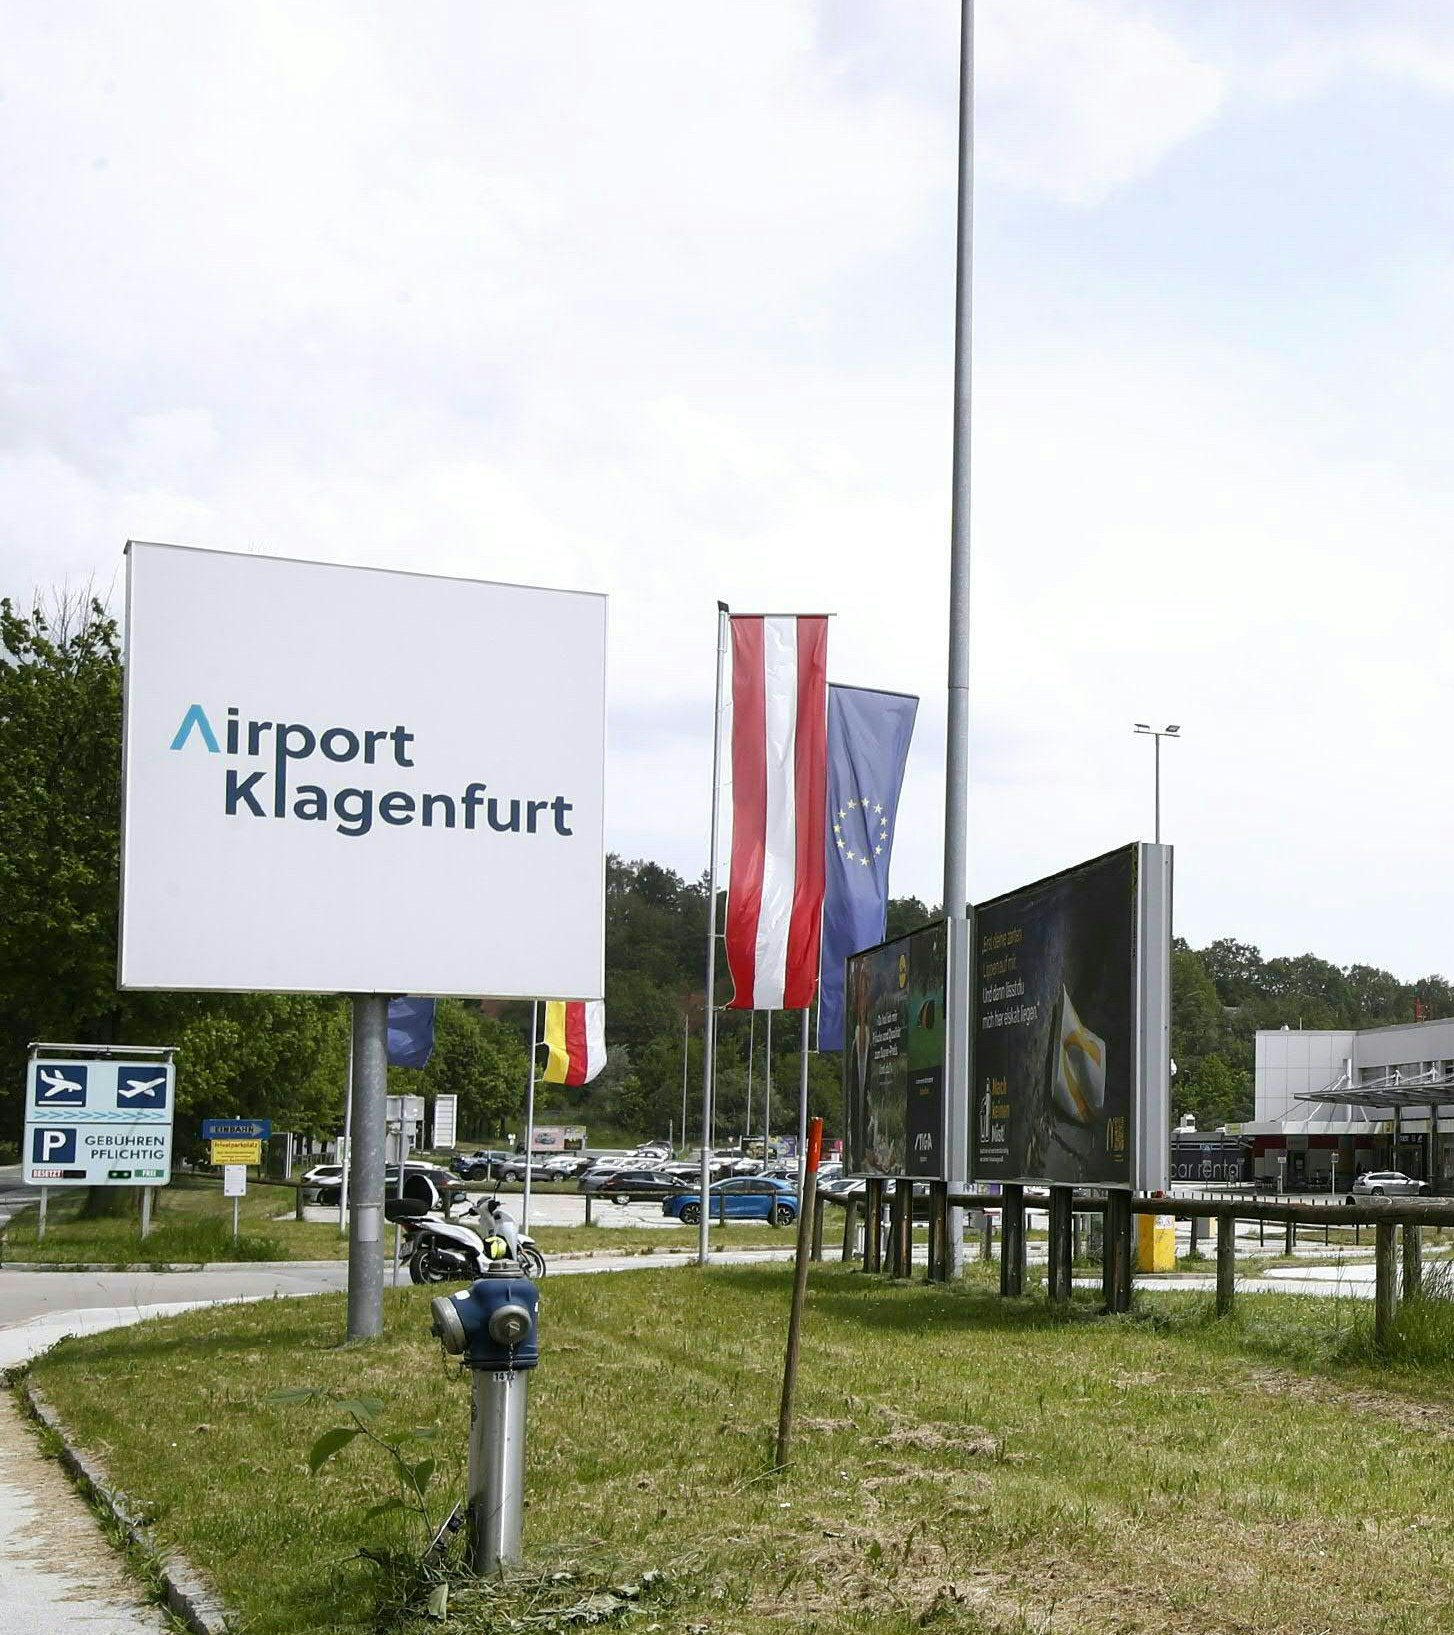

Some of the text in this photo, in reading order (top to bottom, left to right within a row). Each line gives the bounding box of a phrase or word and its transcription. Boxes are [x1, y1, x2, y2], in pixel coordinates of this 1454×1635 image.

[169, 703, 415, 772] Airport
[225, 769, 573, 836] Klagenfurt
[43, 1131, 66, 1161] P
[85, 1133, 165, 1147] GEBÜHREN
[91, 1149, 165, 1161] PFLICHTIG
[1170, 1163, 1193, 1179] car
